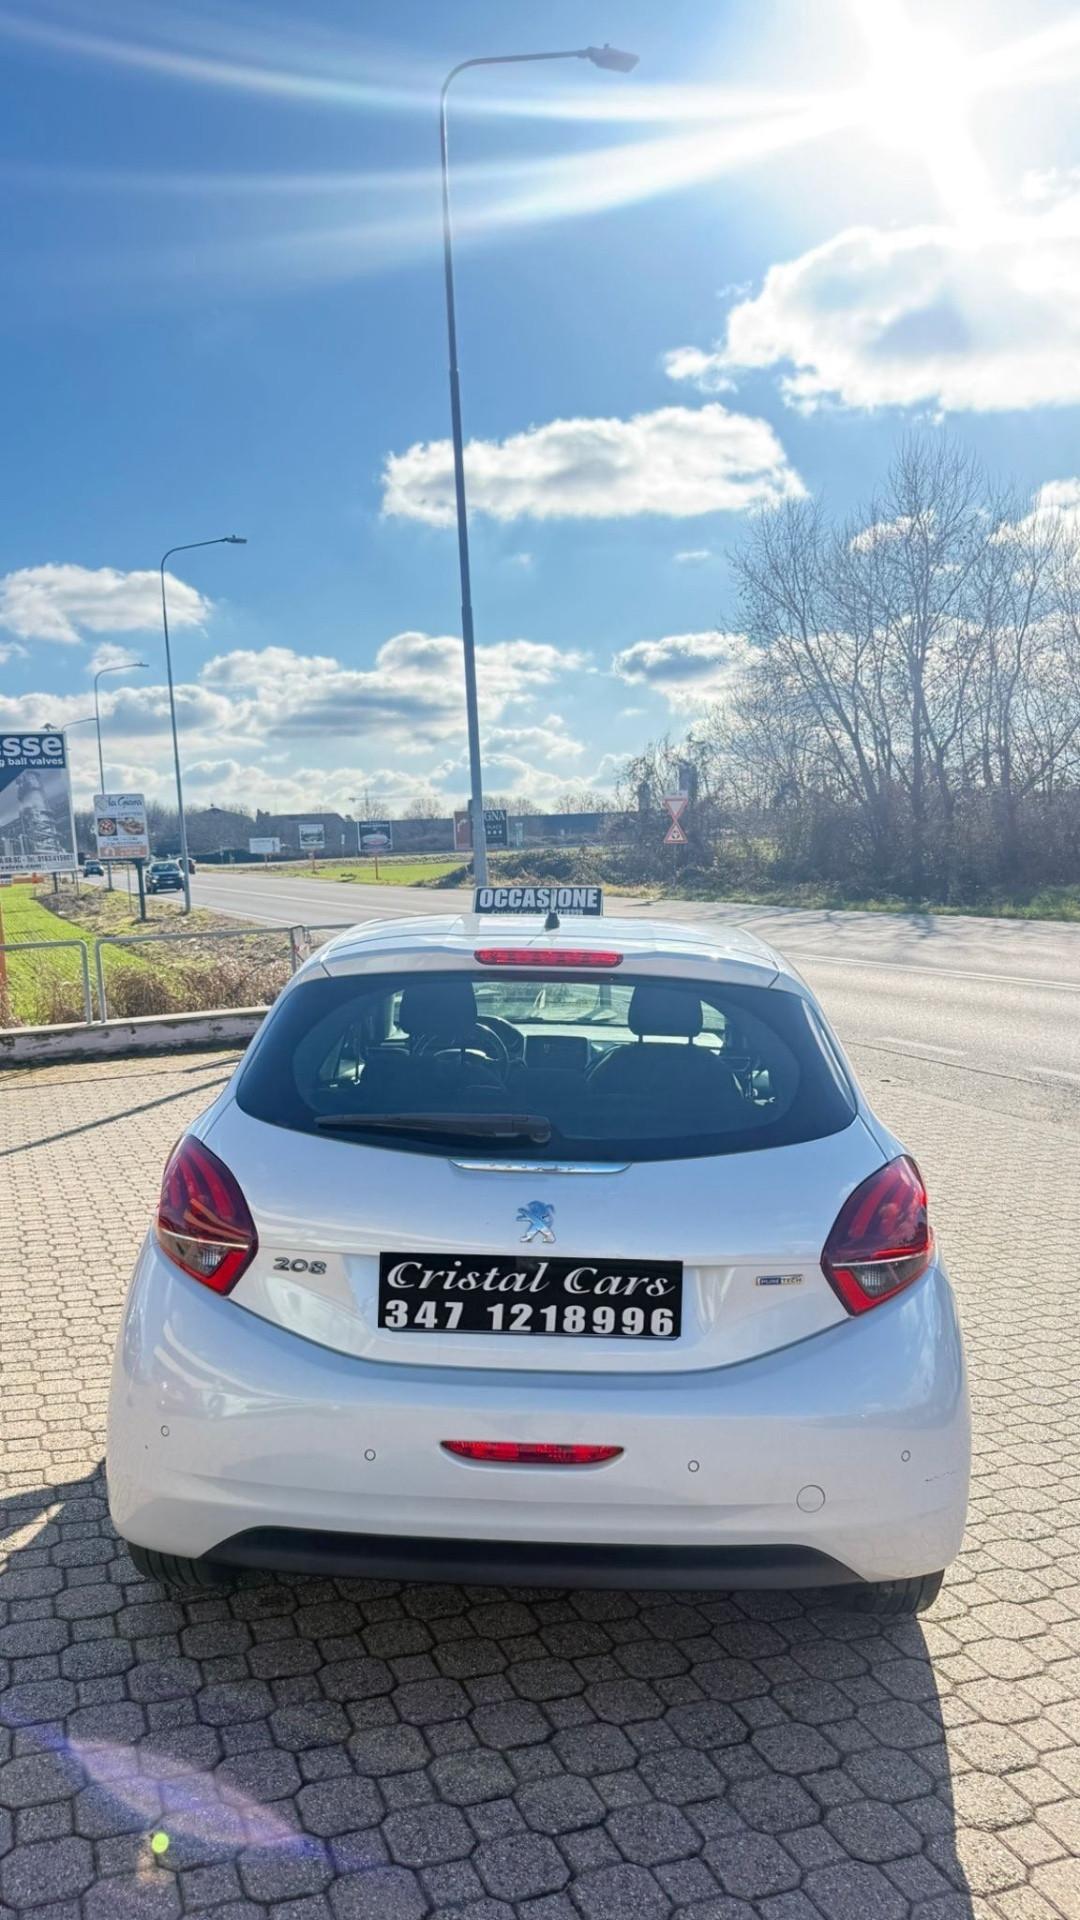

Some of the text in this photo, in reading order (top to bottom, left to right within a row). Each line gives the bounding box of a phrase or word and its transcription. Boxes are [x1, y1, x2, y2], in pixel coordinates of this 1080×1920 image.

[0, 736, 62, 756] sse
[8, 757, 27, 765] ball
[30, 757, 63, 765] valves
[479, 888, 598, 908] OCCASIONE
[273, 1256, 327, 1275] 208
[387, 1260, 676, 1297] Cristal Cars
[384, 1299, 675, 1336] 347 1218996
